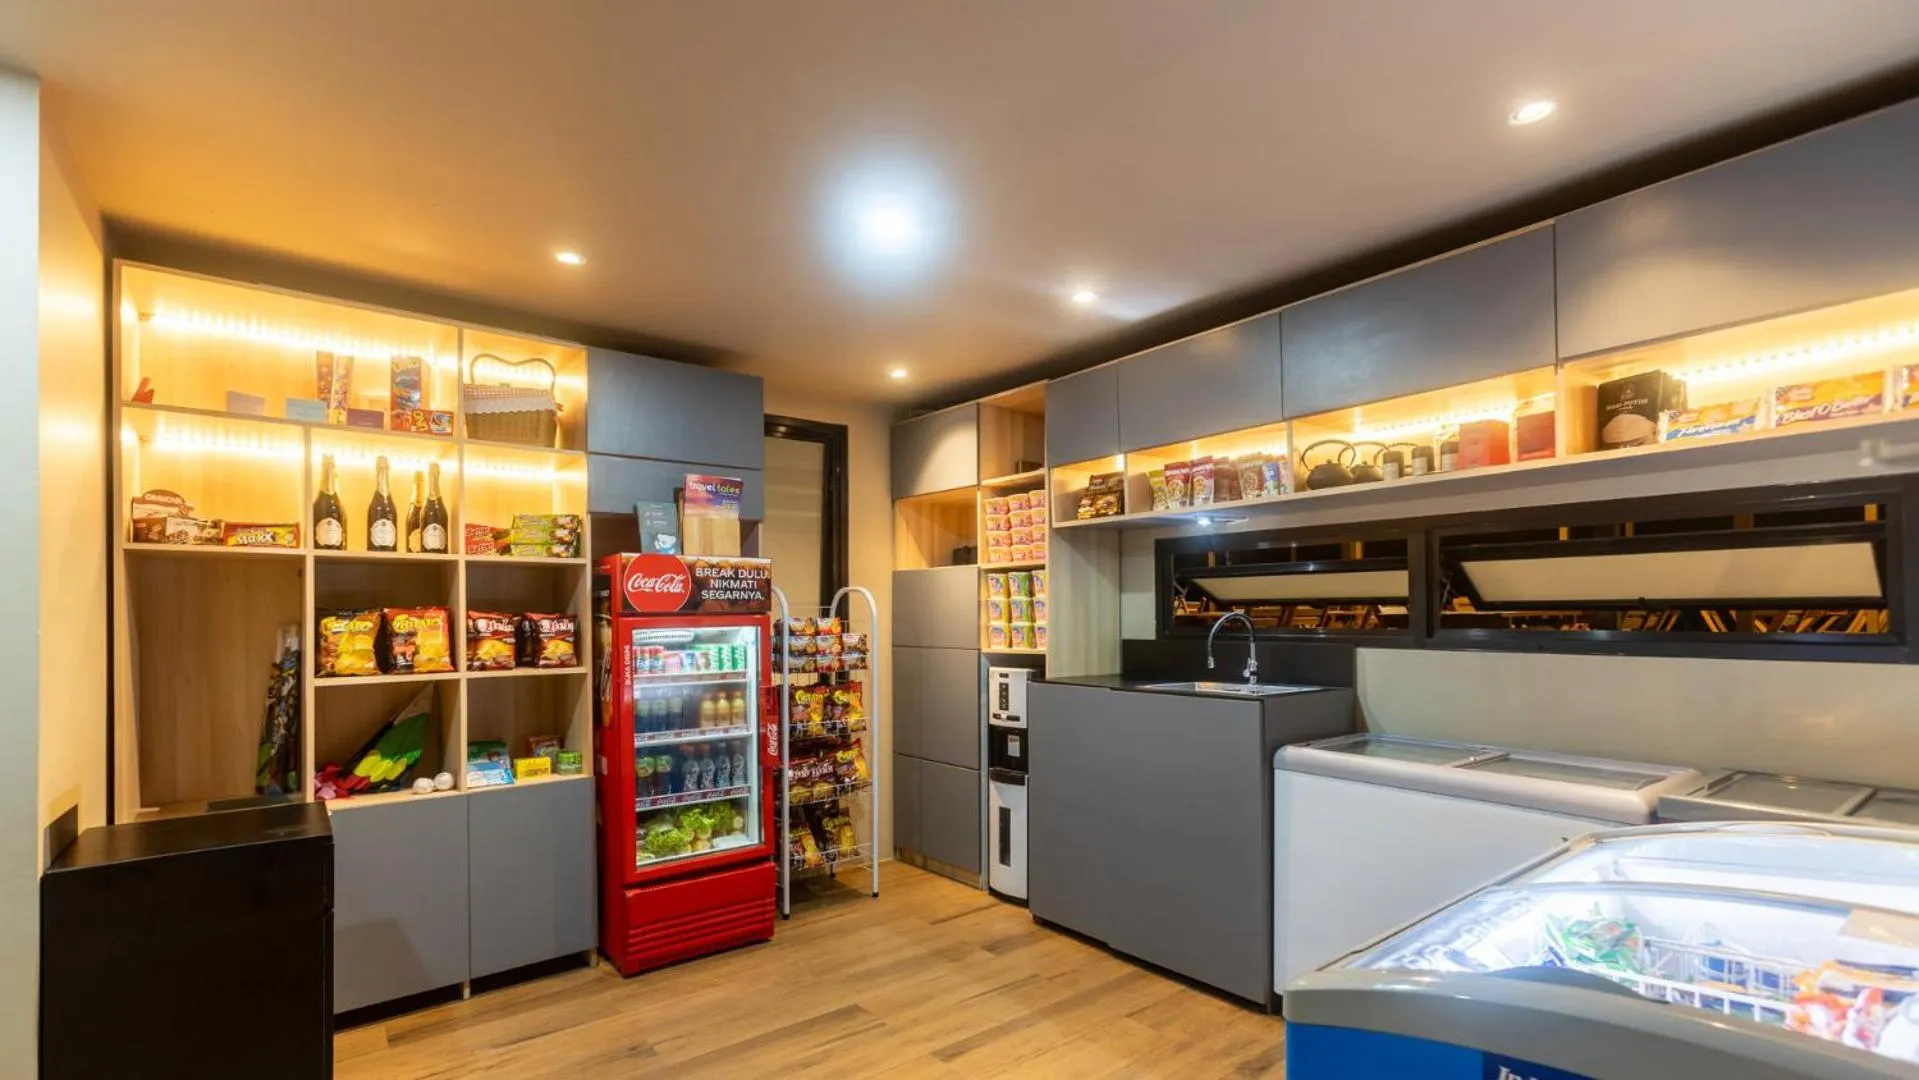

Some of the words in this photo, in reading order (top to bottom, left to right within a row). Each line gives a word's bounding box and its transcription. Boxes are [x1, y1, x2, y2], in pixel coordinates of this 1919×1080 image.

[688, 482, 716, 492] travel
[717, 485, 740, 494] tales
[695, 567, 736, 578] BREAK
[738, 568, 770, 579] DULU.
[627, 572, 685, 593] Coca-Cola
[710, 579, 757, 589] NIKMATI
[701, 590, 765, 600] SEGARNYA.
